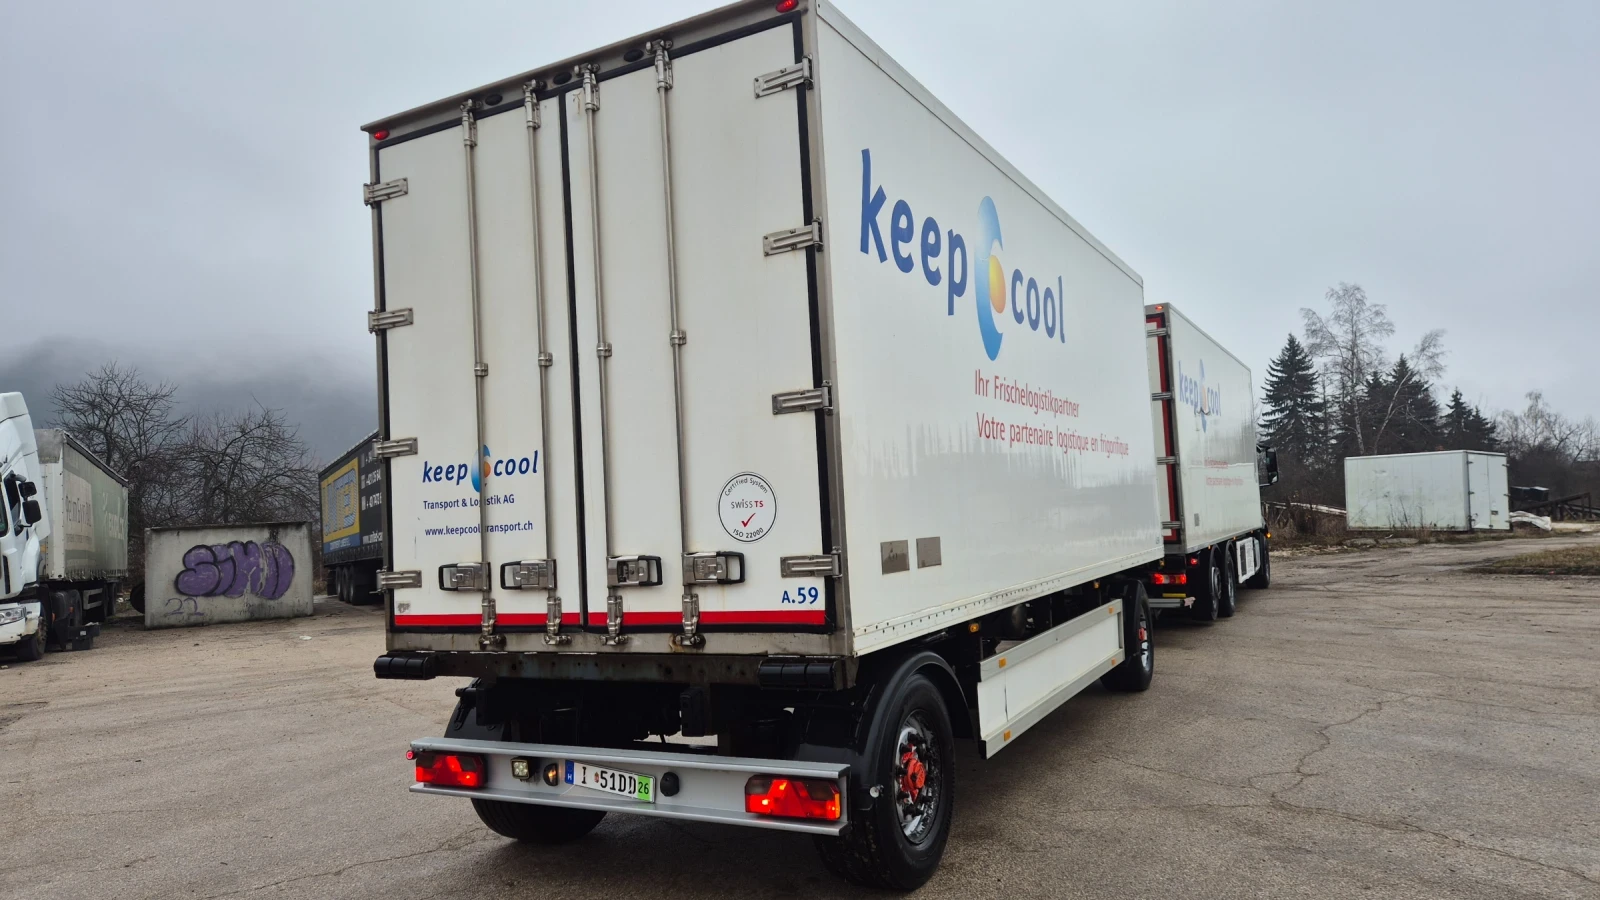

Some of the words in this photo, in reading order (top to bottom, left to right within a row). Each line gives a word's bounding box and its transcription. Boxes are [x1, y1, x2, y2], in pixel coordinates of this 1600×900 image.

[860, 148, 968, 316] keep
[1010, 268, 1066, 344] cool
[974, 369, 990, 398] Ihr
[994, 375, 1080, 418] Frischelogistikpartner
[1178, 360, 1199, 416] keep
[1207, 382, 1221, 417] cool
[976, 412, 1006, 441] Votre
[1009, 422, 1054, 448] partenaire
[1056, 425, 1089, 455] logistique
[1090, 436, 1099, 452] en
[422, 460, 468, 486] keep
[493, 449, 538, 477] cool
[724, 477, 748, 497] Certified
[749, 477, 768, 494] System
[423, 498, 460, 510] Transport
[461, 498, 468, 507] &
[502, 493, 515, 504] AG
[754, 500, 764, 508] TS
[424, 520, 533, 536] www.keepcoolransport.ch
[732, 528, 744, 538] ISO
[745, 527, 764, 539] 22000
[781, 586, 819, 605] A.59
[567, 773, 572, 781] H
[638, 781, 650, 795] 26
